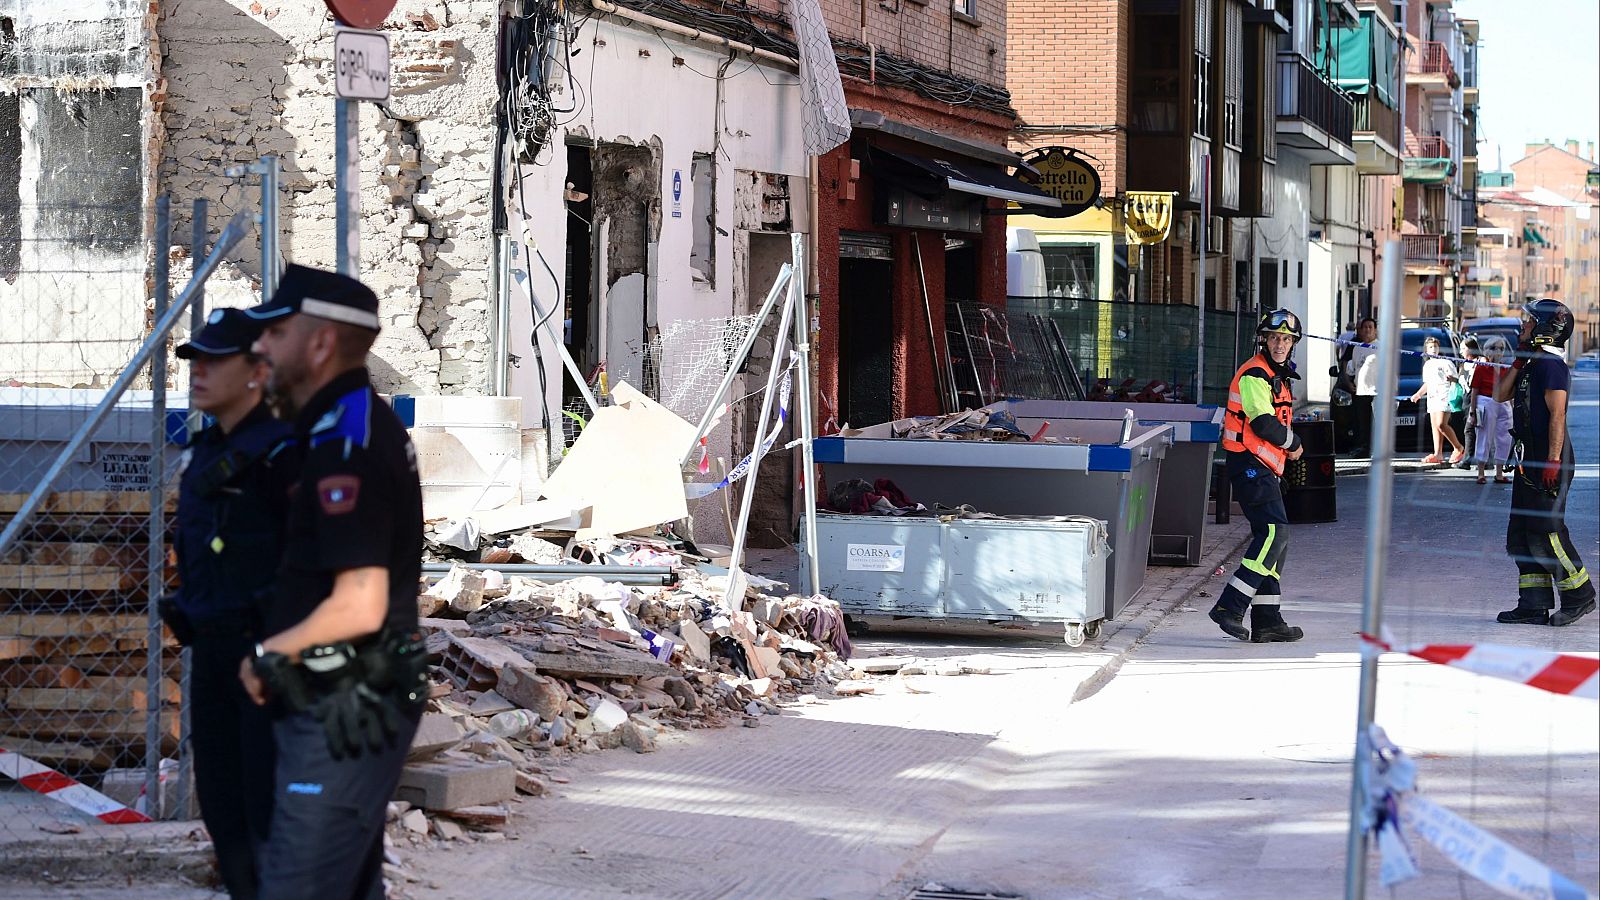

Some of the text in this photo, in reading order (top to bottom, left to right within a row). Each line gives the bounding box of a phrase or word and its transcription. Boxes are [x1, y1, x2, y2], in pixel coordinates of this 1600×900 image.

[1040, 169, 1087, 185] strella
[1045, 185, 1084, 201] alicia
[1400, 417, 1414, 425] HRV
[730, 455, 752, 480] PASAR
[850, 547, 891, 558] COARSA
